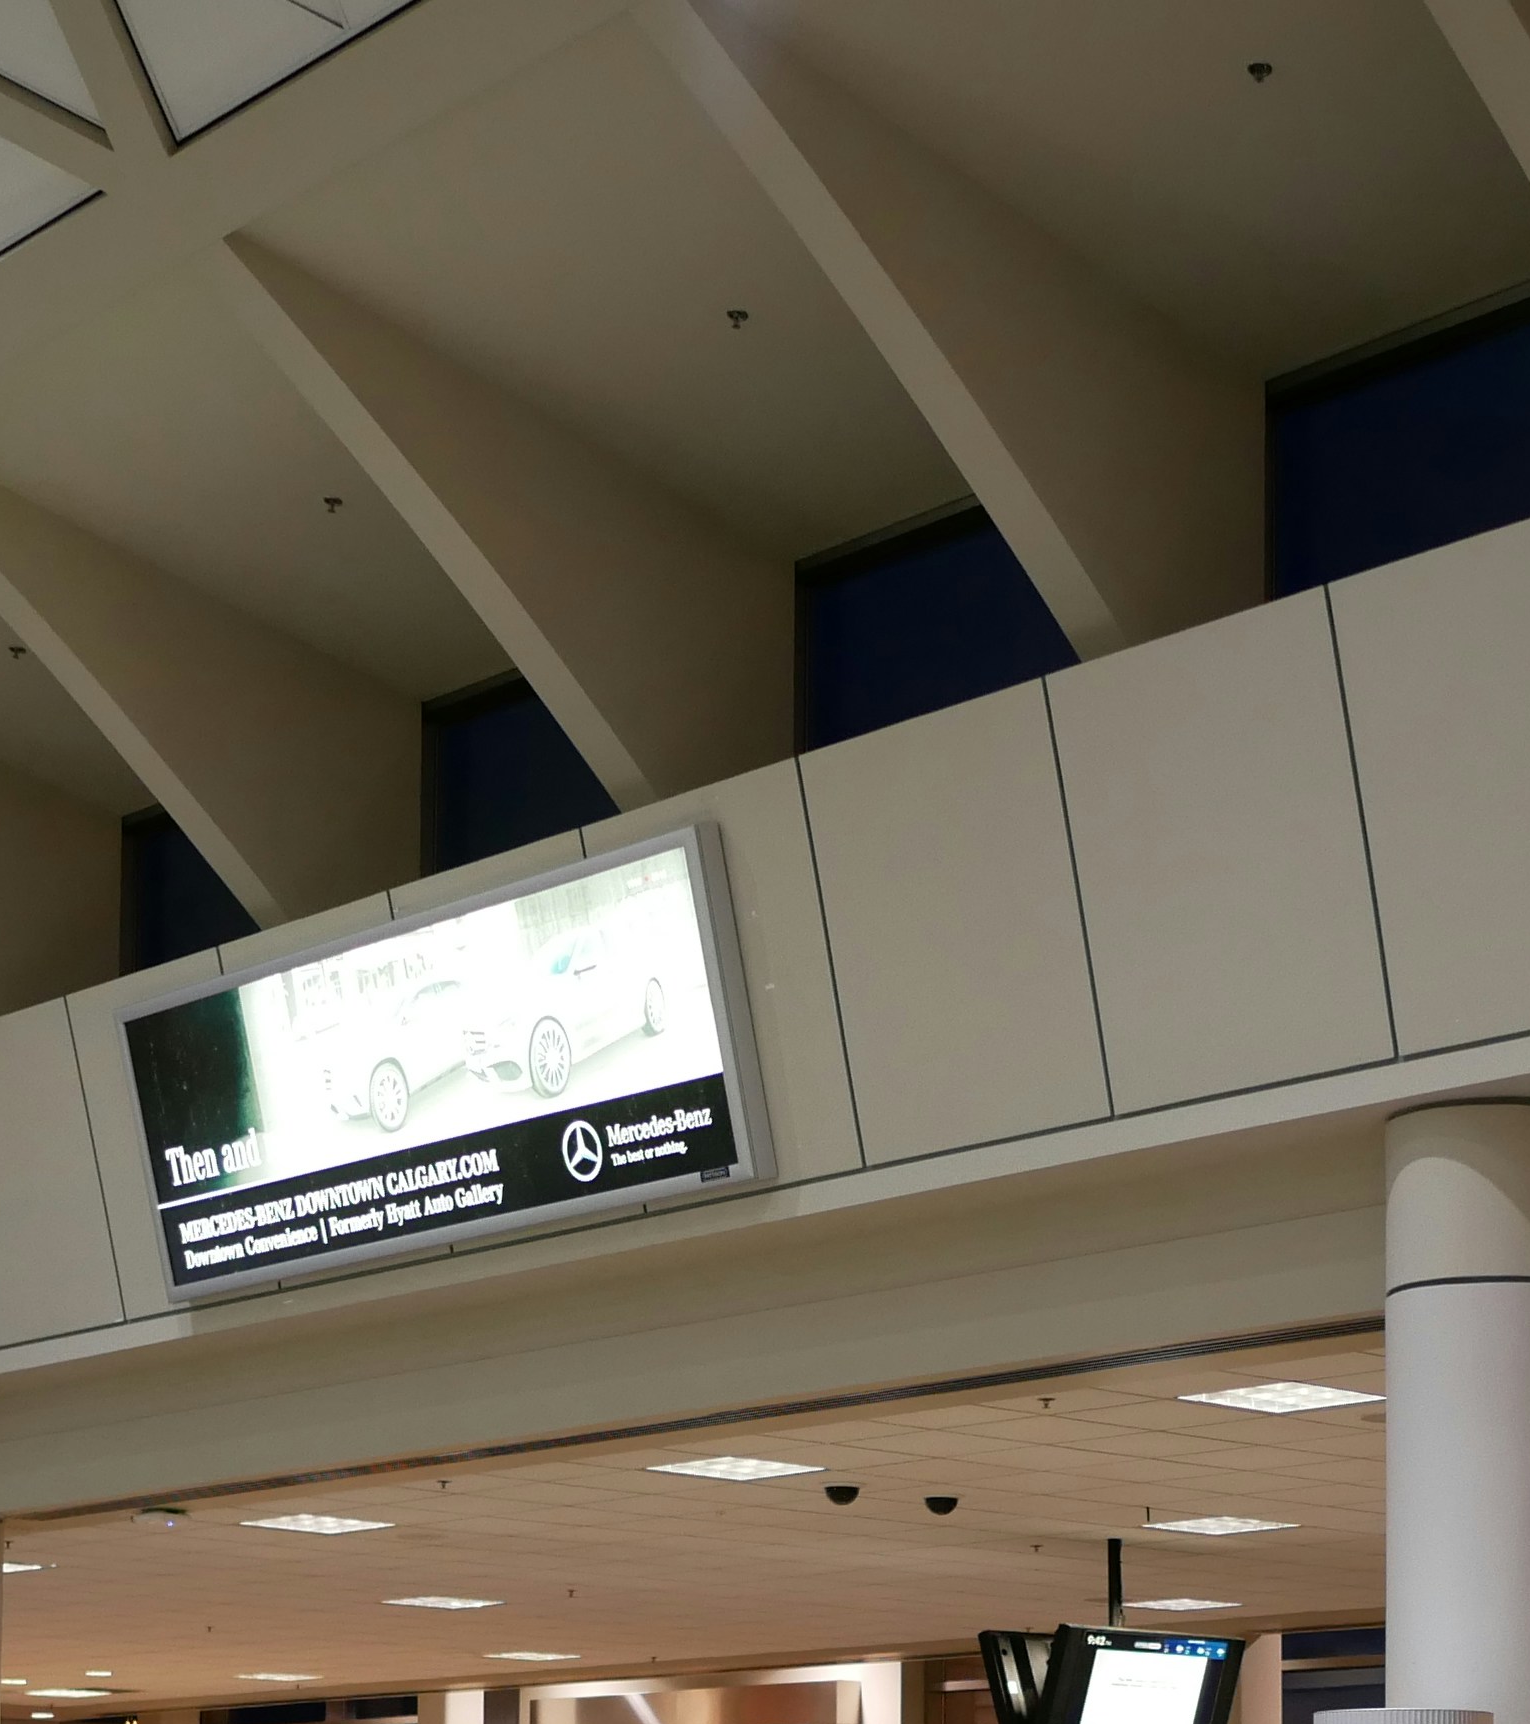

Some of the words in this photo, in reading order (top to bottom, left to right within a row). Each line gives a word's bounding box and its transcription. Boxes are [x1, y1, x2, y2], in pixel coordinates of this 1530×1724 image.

[165, 1146, 220, 1187] Then
[221, 1127, 262, 1173] and
[606, 1107, 712, 1147] Mercedes-Benz
[610, 1152, 627, 1167] The
[627, 1148, 644, 1163] best
[644, 1147, 654, 1159] or
[179, 1198, 296, 1244] MERCEDES-BENZ
[296, 1175, 385, 1217] DOWNTOWN
[386, 1148, 500, 1196] CALGARY.COM
[184, 1241, 245, 1269] Downtown
[245, 1224, 318, 1255] Convenience
[328, 1207, 384, 1237] Formerly
[385, 1199, 423, 1226] Hyatt
[424, 1193, 454, 1216] Auto
[454, 1183, 504, 1209] Gallery
